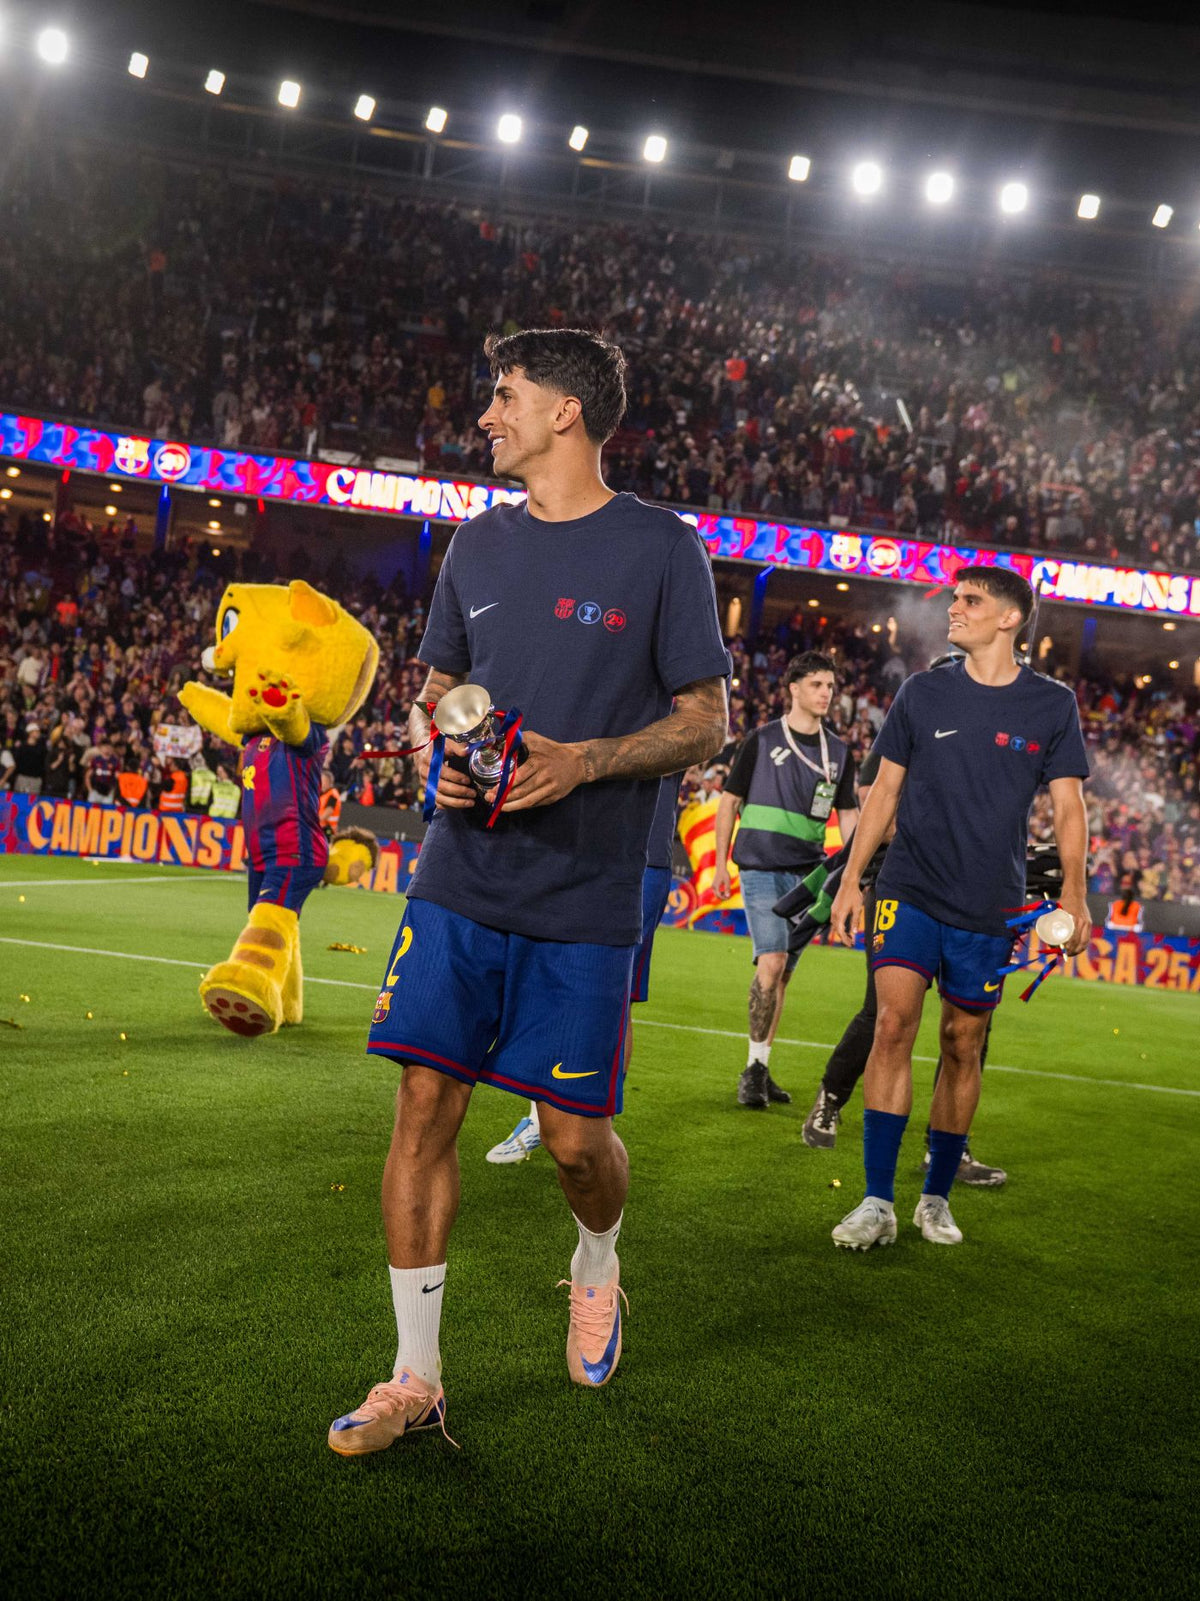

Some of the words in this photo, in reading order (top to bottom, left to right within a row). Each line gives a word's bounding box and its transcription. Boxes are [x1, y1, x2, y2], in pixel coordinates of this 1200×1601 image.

[27, 800, 224, 868] CAMPIONS
[664, 888, 690, 915] 9
[873, 899, 899, 933] 18
[386, 926, 413, 987] 2
